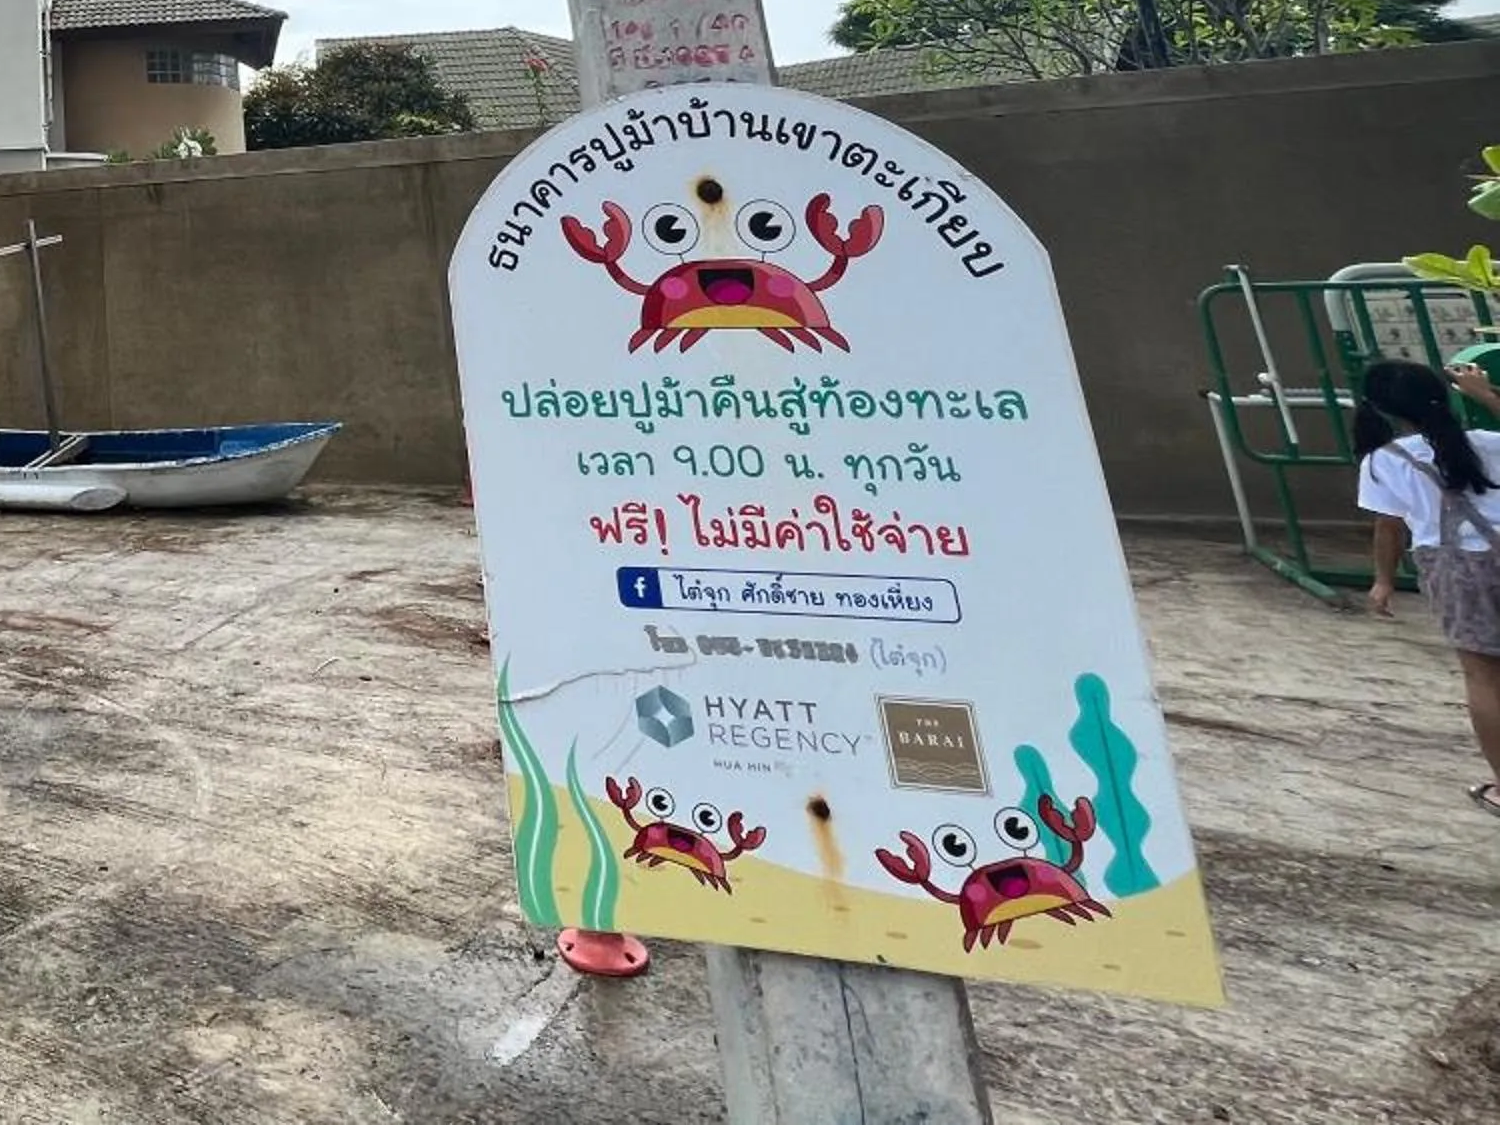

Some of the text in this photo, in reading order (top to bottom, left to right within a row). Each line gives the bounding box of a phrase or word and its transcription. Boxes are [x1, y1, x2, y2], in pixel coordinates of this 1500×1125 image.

[487, 97, 1006, 279] ธนาคารปูม้าบ้านเขาตะเกียบ
[500, 375, 1030, 435] ปล่อยปูม้าคืนสู่ท้องทะเล
[577, 441, 963, 497] เวลา 9.00 น. ทุกวัน
[589, 492, 971, 557] ฟรี! ไม่มีค่าใช้จ่าย
[703, 694, 819, 725] HYATT
[706, 723, 863, 757] REGENCY
[896, 729, 966, 750] BARAI
[712, 758, 772, 773] HUA HIN
